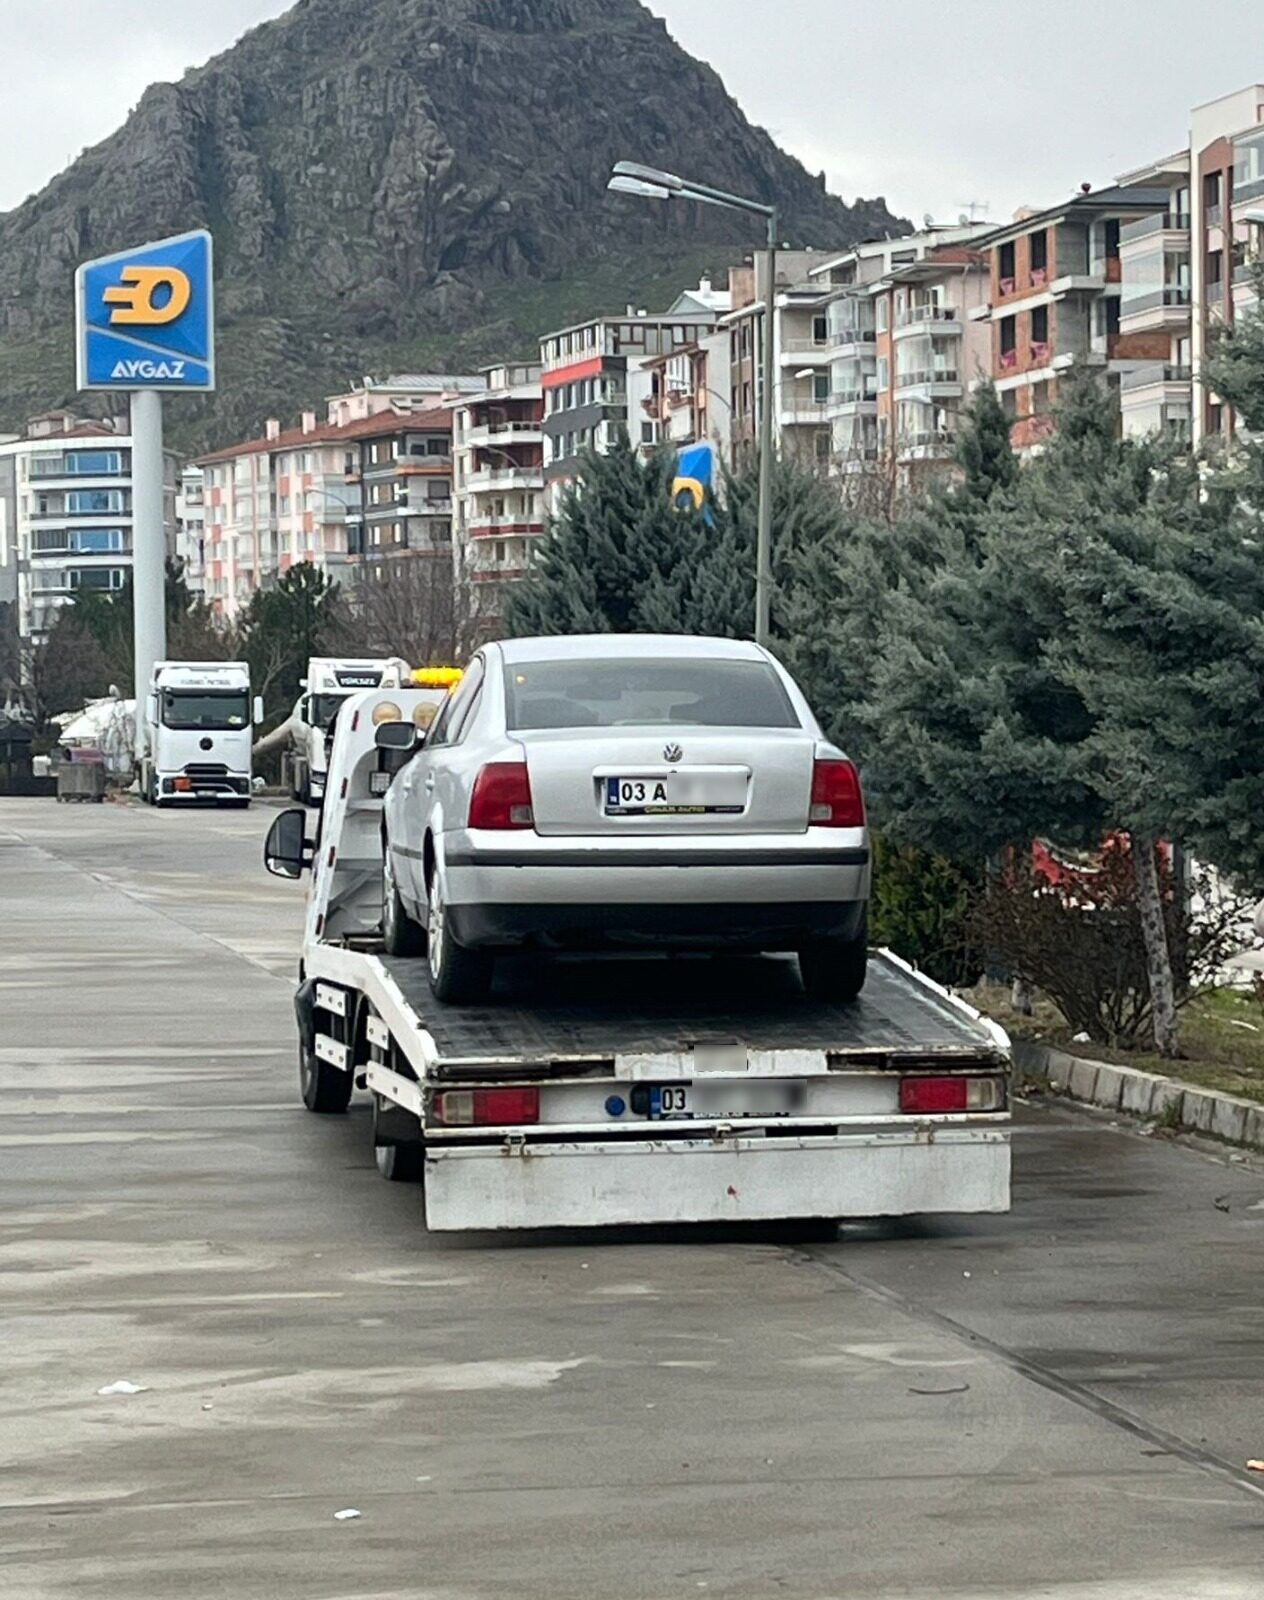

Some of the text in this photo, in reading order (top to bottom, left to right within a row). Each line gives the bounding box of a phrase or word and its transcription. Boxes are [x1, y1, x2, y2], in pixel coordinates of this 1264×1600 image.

[110, 359, 185, 379] AYGAZ
[621, 782, 646, 802] 03
[662, 1087, 686, 1111] 03
